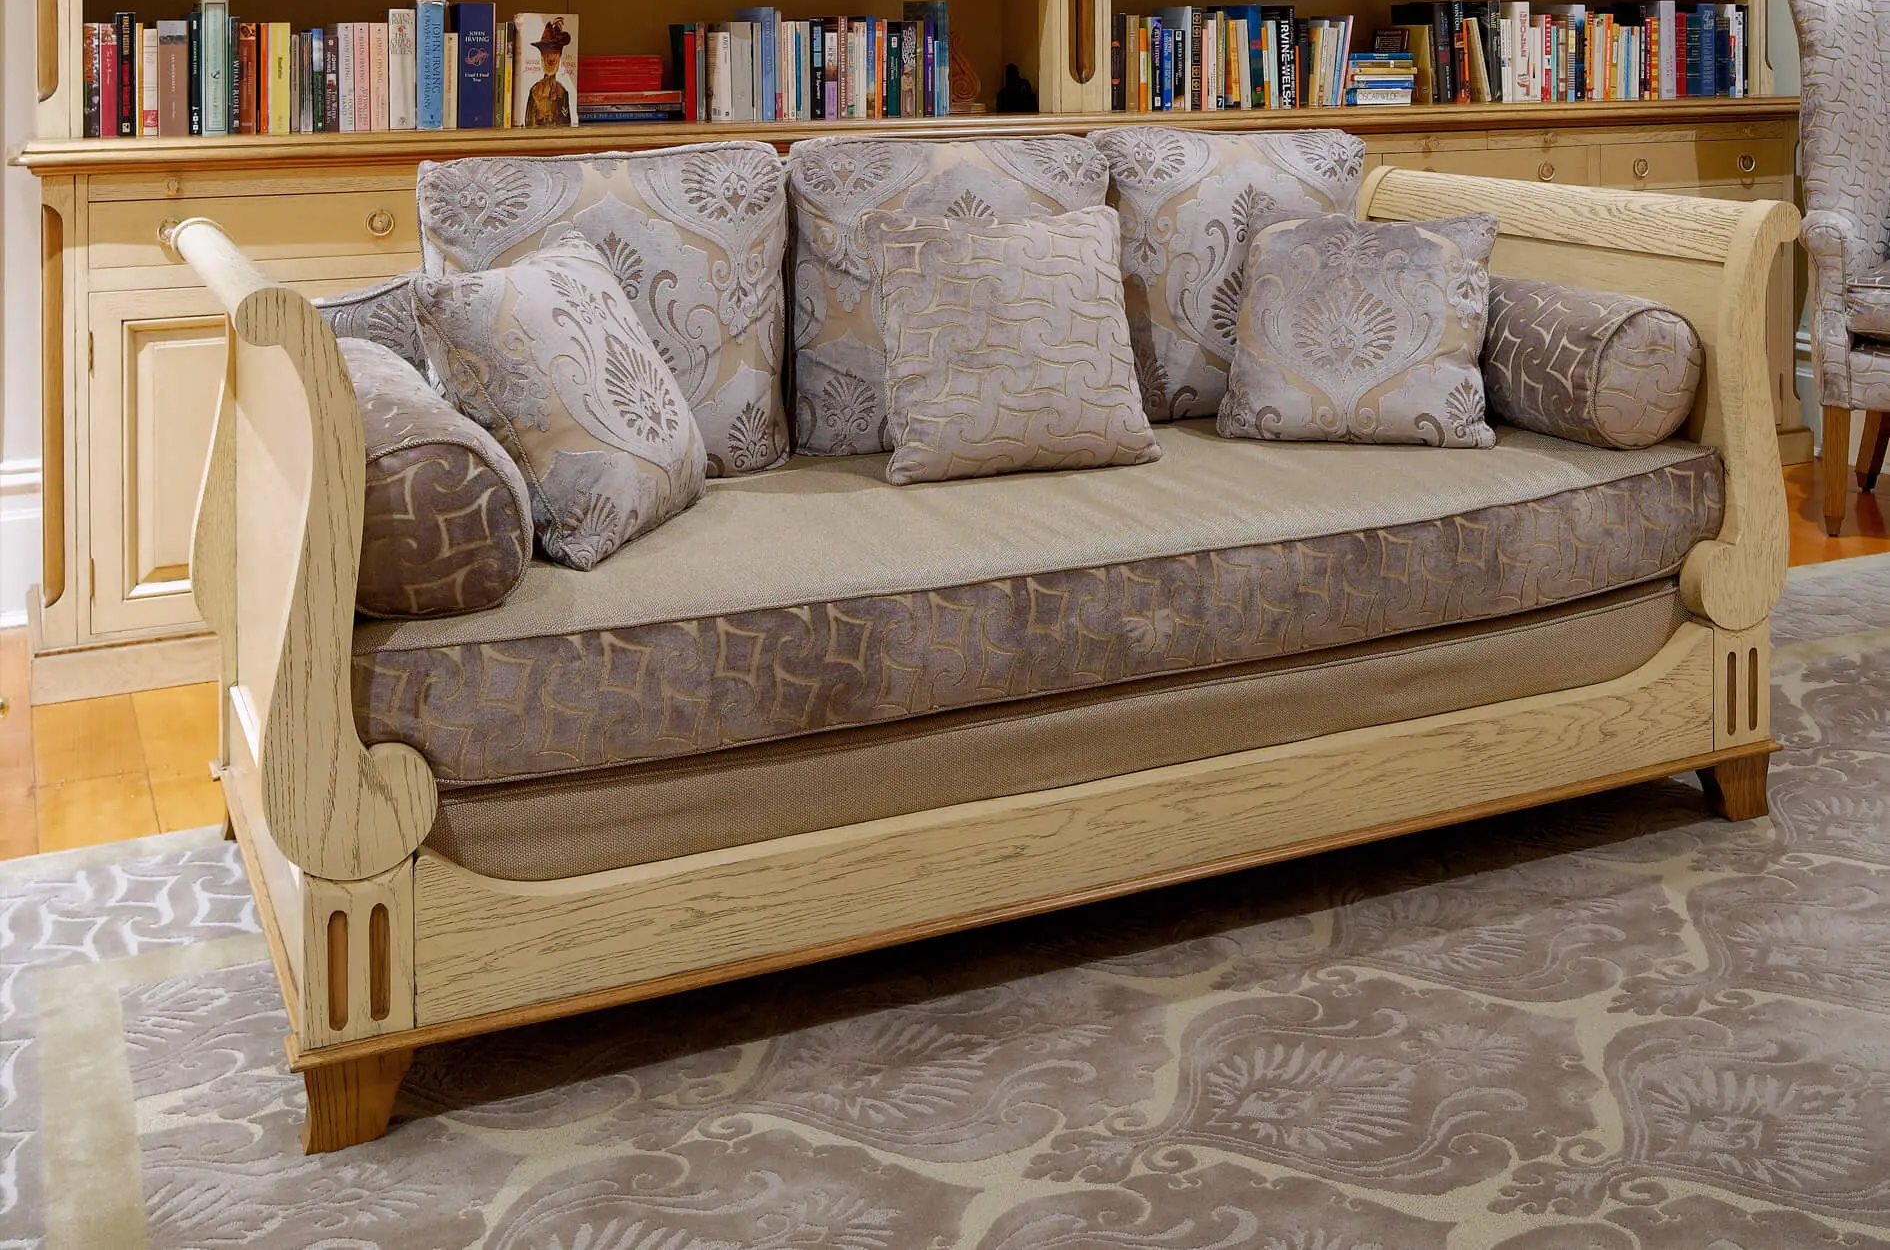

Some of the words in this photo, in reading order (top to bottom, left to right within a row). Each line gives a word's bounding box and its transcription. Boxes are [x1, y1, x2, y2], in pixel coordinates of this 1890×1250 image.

[432, 23, 441, 53] JOHN
[1281, 20, 1291, 62] IRVINE
[232, 60, 240, 86] WHALE
[432, 55, 441, 94] IRVING
[1281, 64, 1292, 108] WELSH
[232, 89, 240, 115] RIDER
